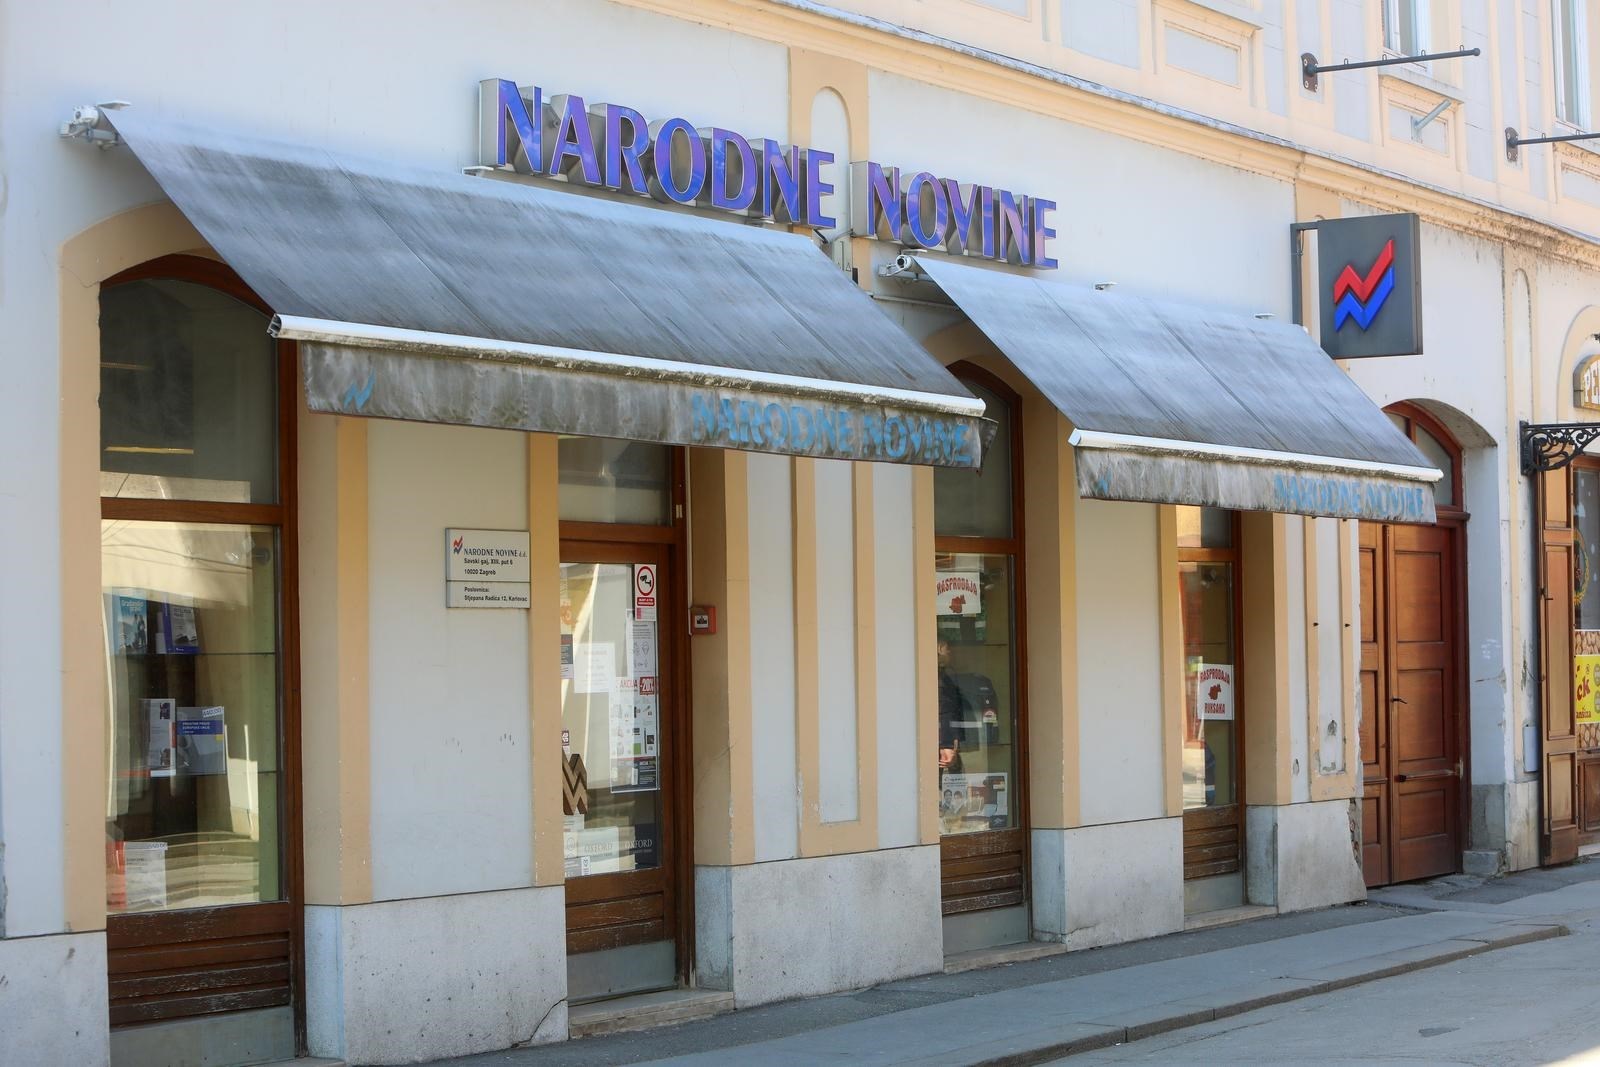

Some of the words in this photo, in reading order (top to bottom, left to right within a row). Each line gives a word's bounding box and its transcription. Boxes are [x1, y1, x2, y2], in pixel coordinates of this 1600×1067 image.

[497, 78, 837, 228] NARODNE
[867, 161, 1058, 269] NOVINE
[692, 395, 854, 451] NARODNE
[863, 415, 973, 463] NOVINE
[1273, 473, 1362, 513] NARODNE
[1366, 483, 1424, 517] NOVINE
[464, 548, 494, 556] NARODNE
[496, 549, 517, 557] NOVINE
